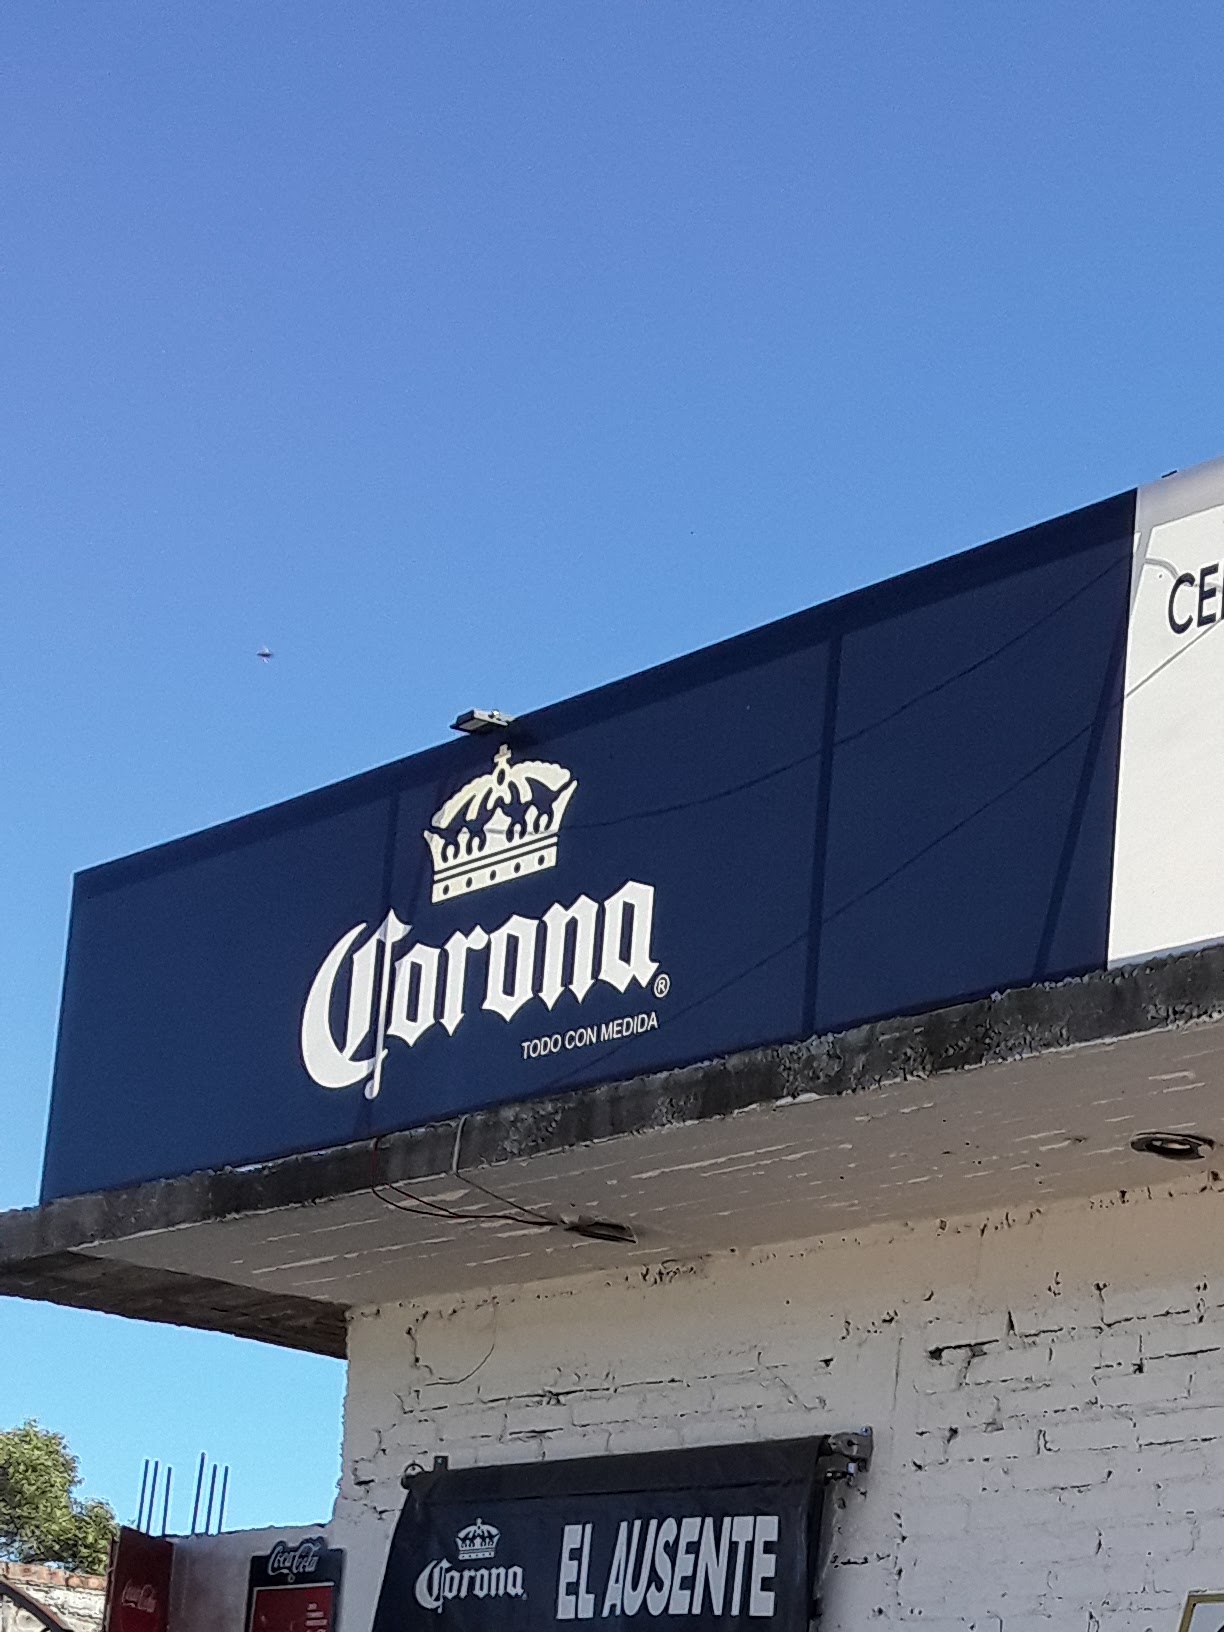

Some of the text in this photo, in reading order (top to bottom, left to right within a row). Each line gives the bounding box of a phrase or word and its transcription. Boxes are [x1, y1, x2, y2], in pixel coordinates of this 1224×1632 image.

[302, 880, 659, 1100] Corona
[521, 1011, 659, 1060] TODO CON MEDIDA
[414, 1515, 780, 1620] Corona EL AUSENTE
